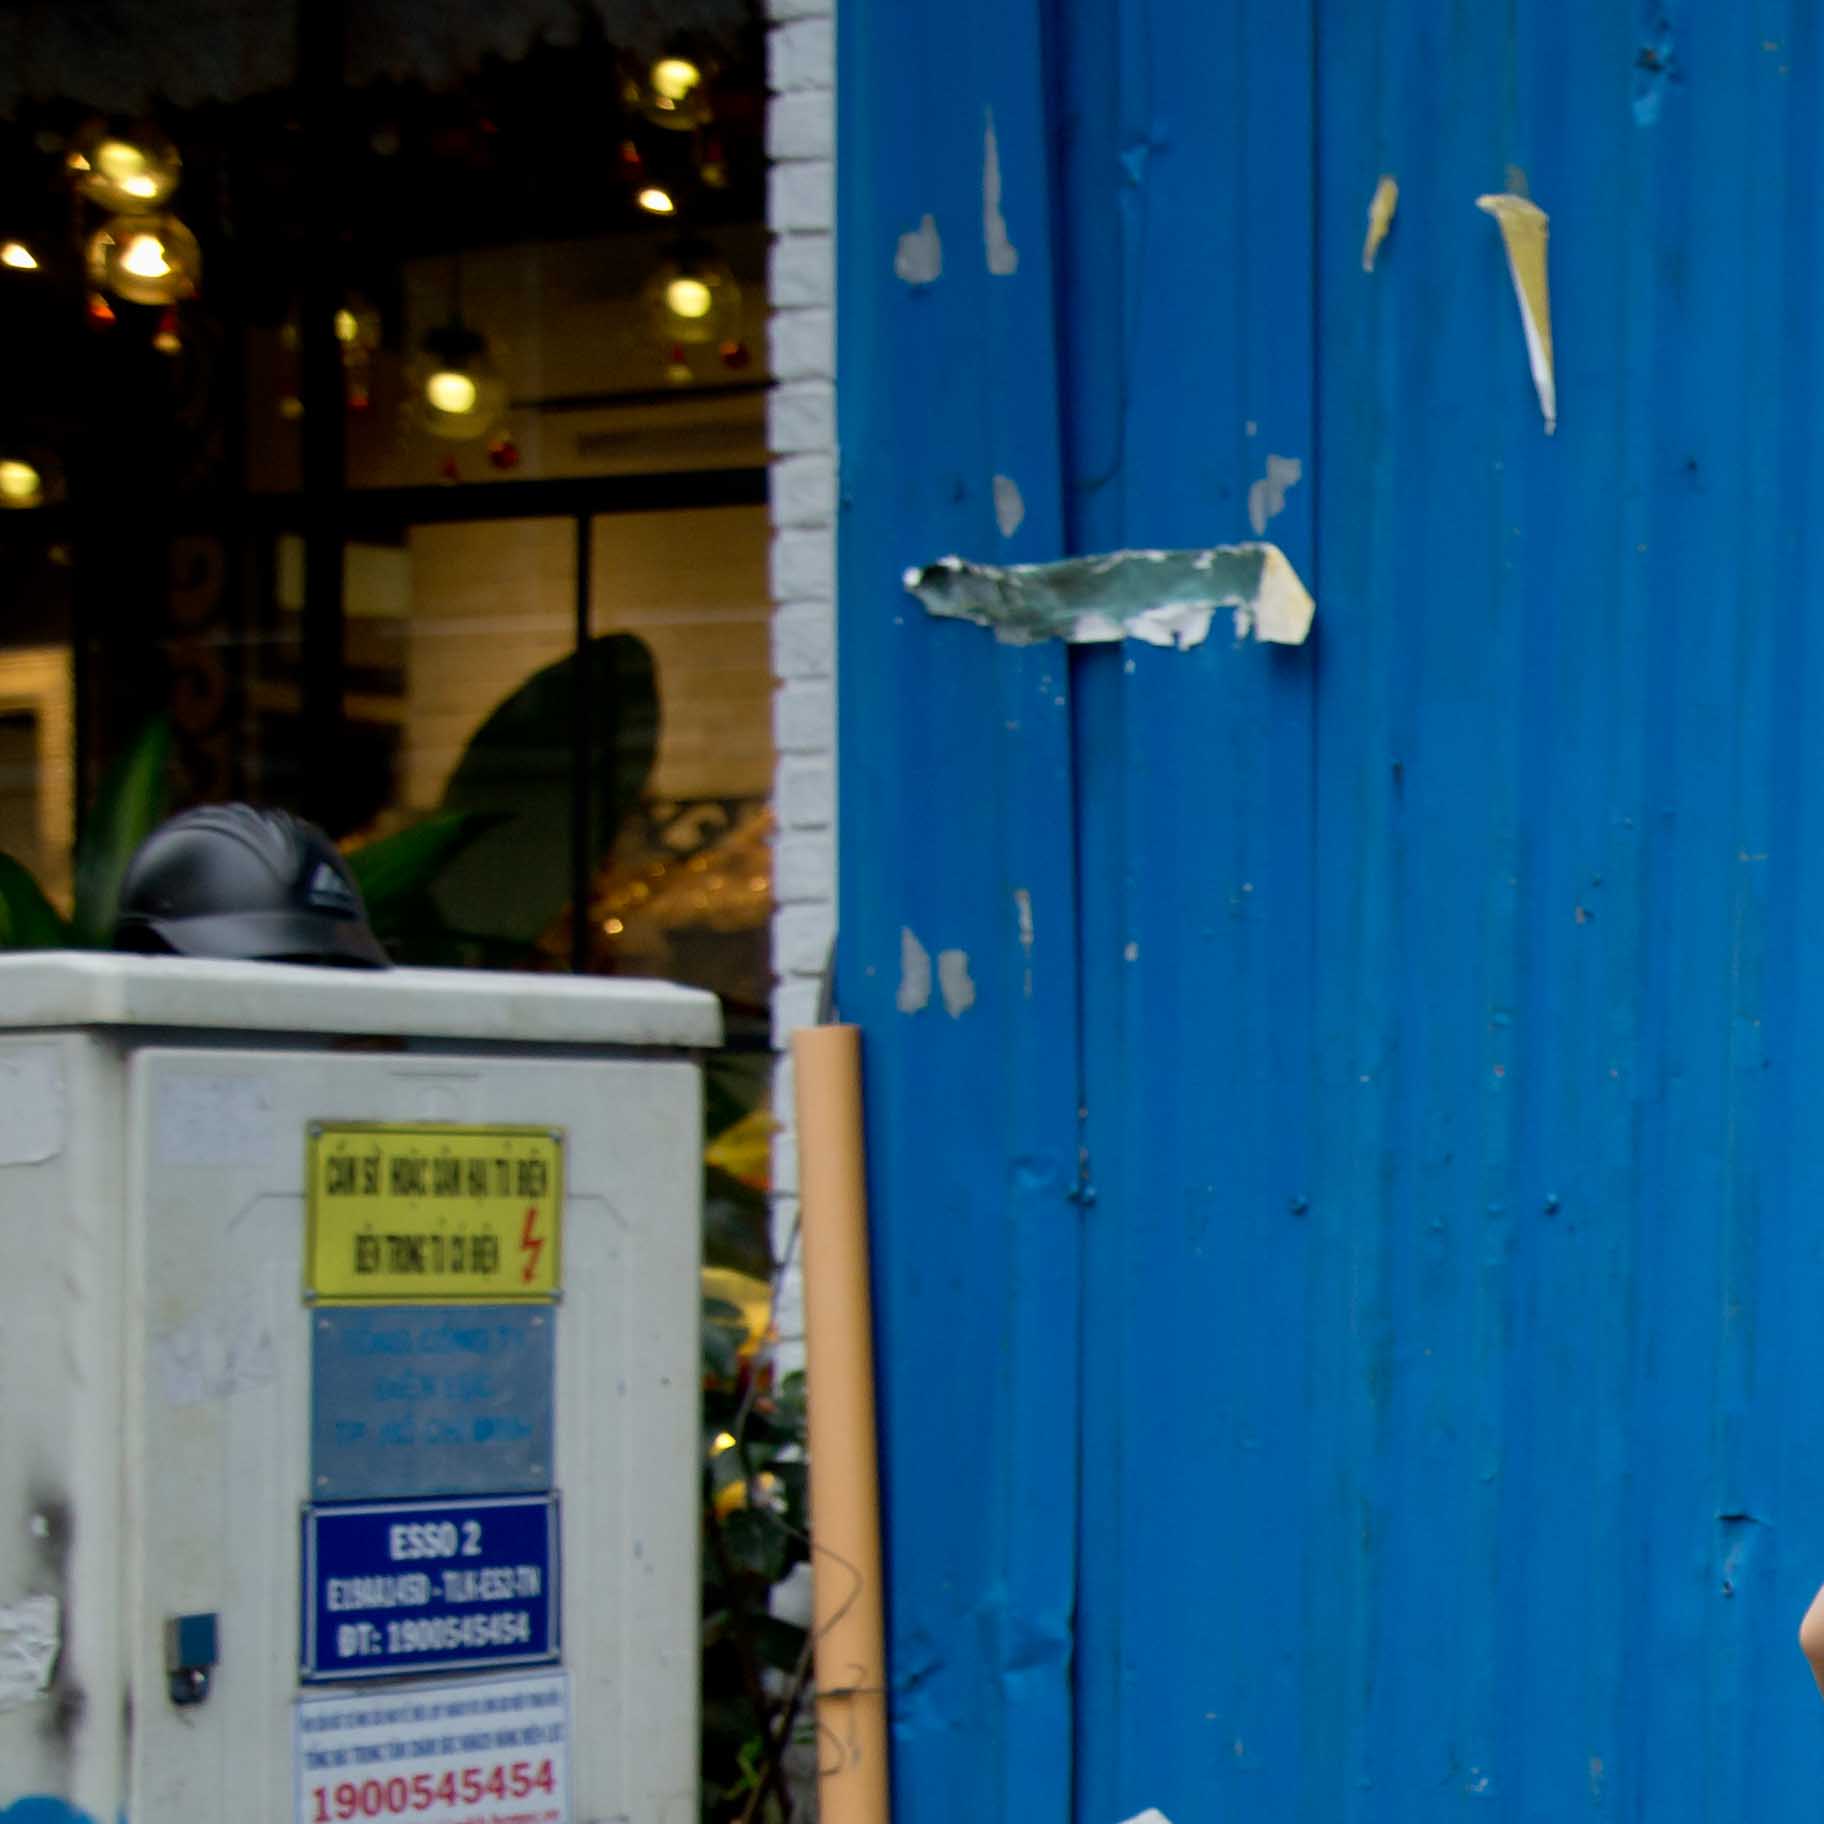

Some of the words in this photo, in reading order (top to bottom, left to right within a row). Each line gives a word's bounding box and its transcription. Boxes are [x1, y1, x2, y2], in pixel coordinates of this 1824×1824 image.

[389, 1520, 458, 1561] ESSO
[461, 1519, 482, 1557] 2
[387, 1611, 531, 1654] 1900545454
[312, 1758, 556, 1824] 1900545454
